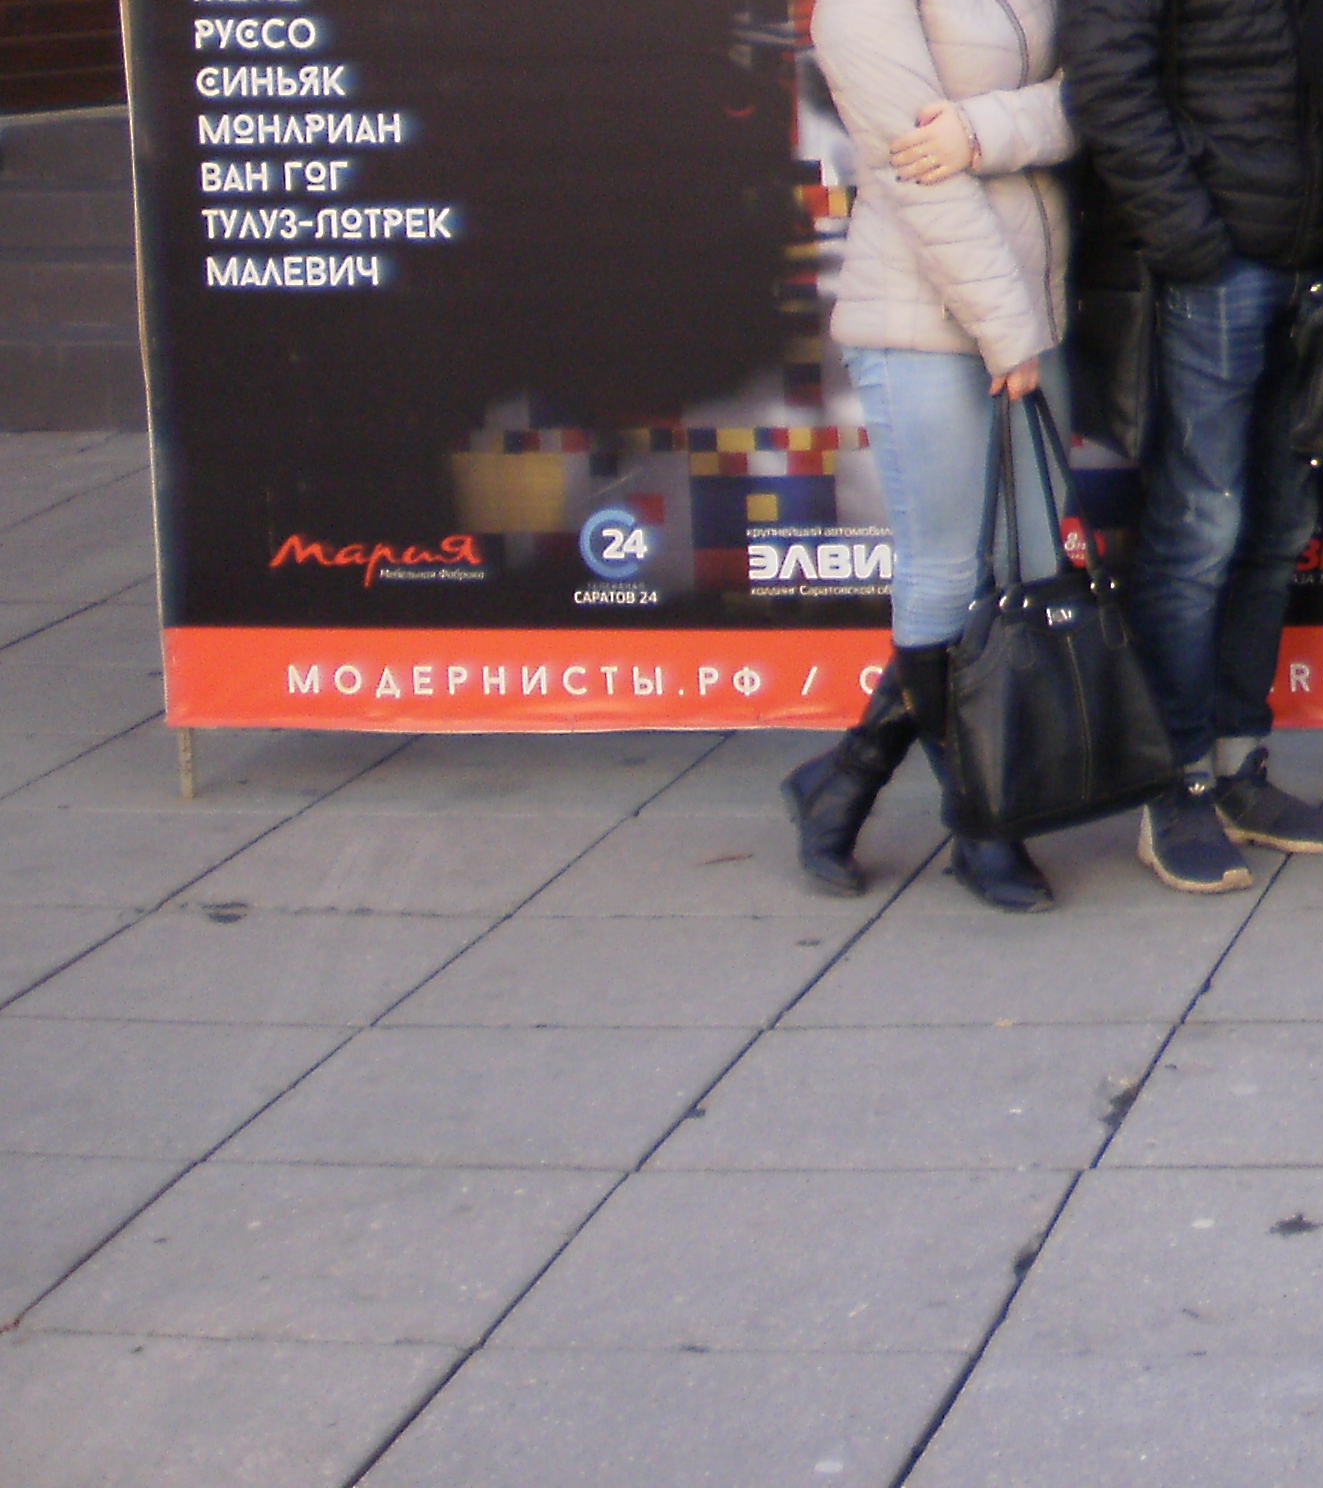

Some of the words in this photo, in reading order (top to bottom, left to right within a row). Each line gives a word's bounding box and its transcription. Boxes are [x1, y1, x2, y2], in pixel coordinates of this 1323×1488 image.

[194, 17, 318, 49] РУССО
[196, 65, 346, 97] СИНЬЯК
[201, 161, 268, 192] ВАН
[284, 161, 348, 192] ГОГ
[202, 207, 452, 240] ТУЛУЗ-ЛОТРЕК
[206, 256, 379, 287] МАЛЕВИЧ
[574, 592, 635, 604] САРАТОВ
[640, 592, 657, 604] 24
[288, 665, 761, 699] МОДЕРНИСТЫ.РФ
